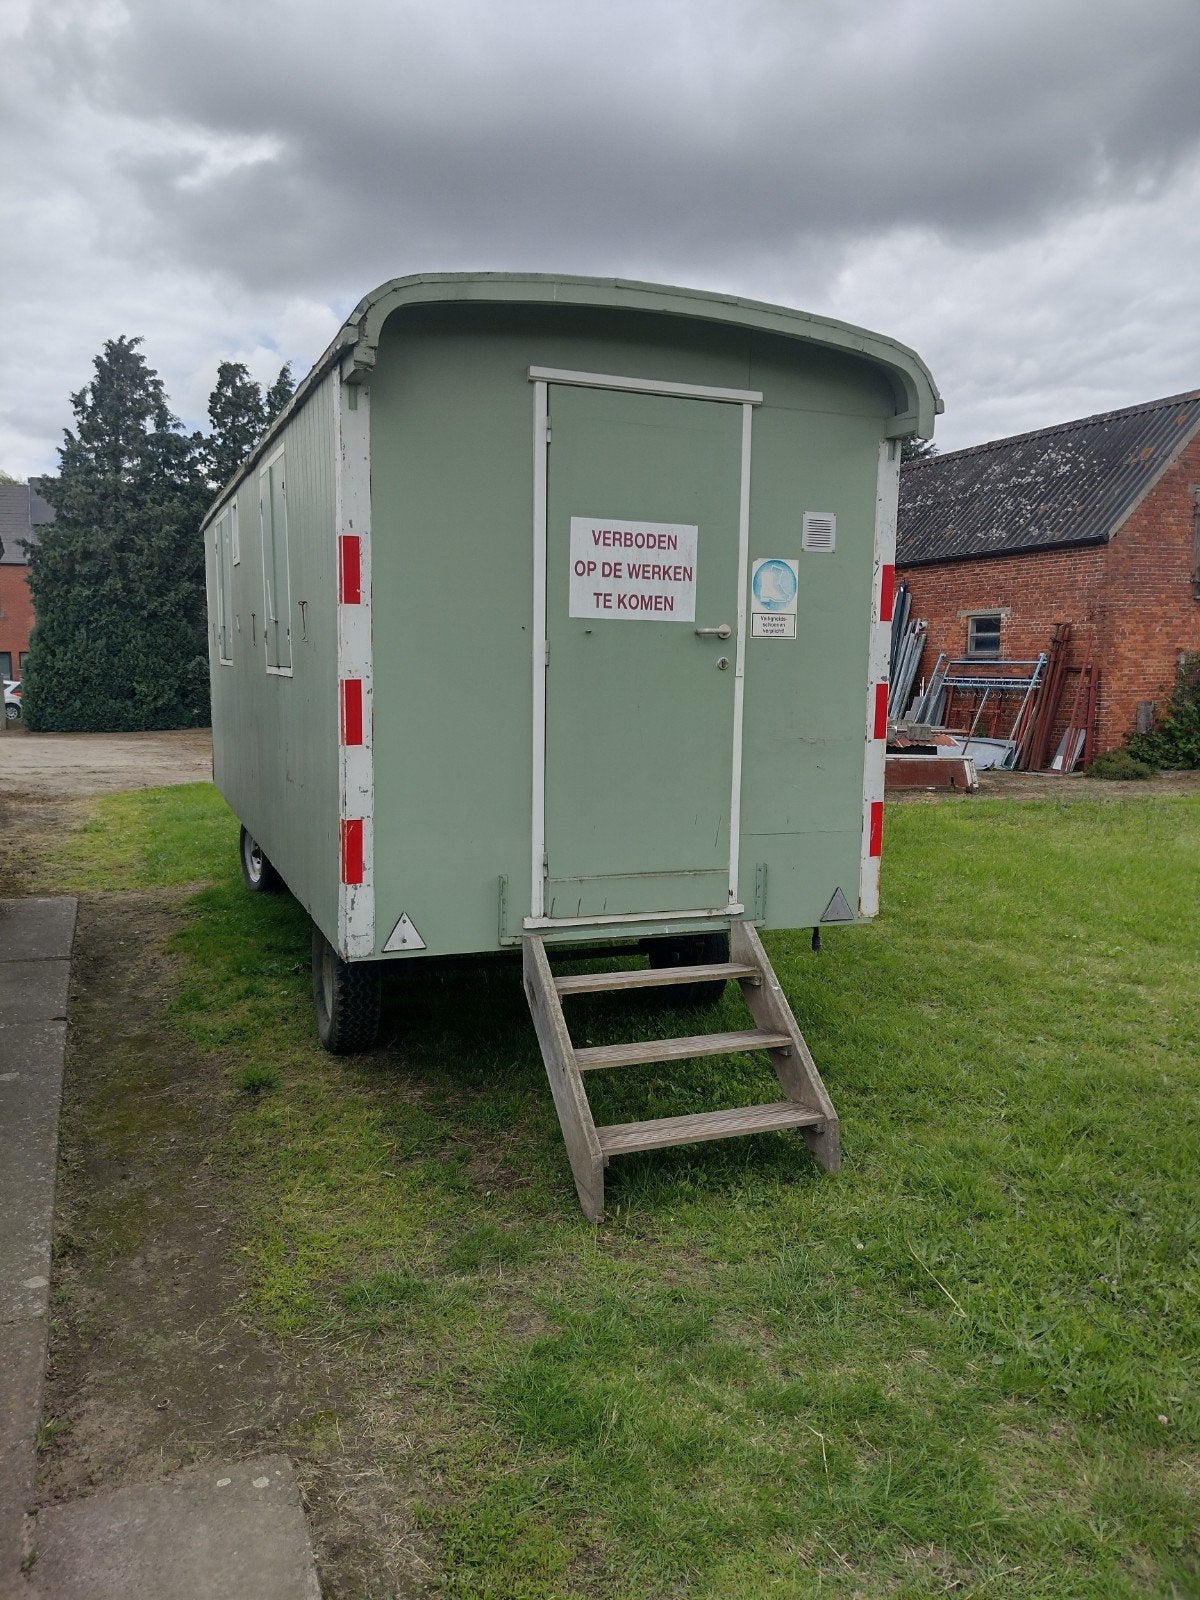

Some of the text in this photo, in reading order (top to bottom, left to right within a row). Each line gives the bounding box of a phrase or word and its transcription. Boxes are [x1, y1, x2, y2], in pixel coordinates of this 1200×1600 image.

[592, 530, 678, 550] VERBODEN
[574, 560, 693, 581] OP DE WERKEN
[593, 592, 674, 611] TE KOMEN
